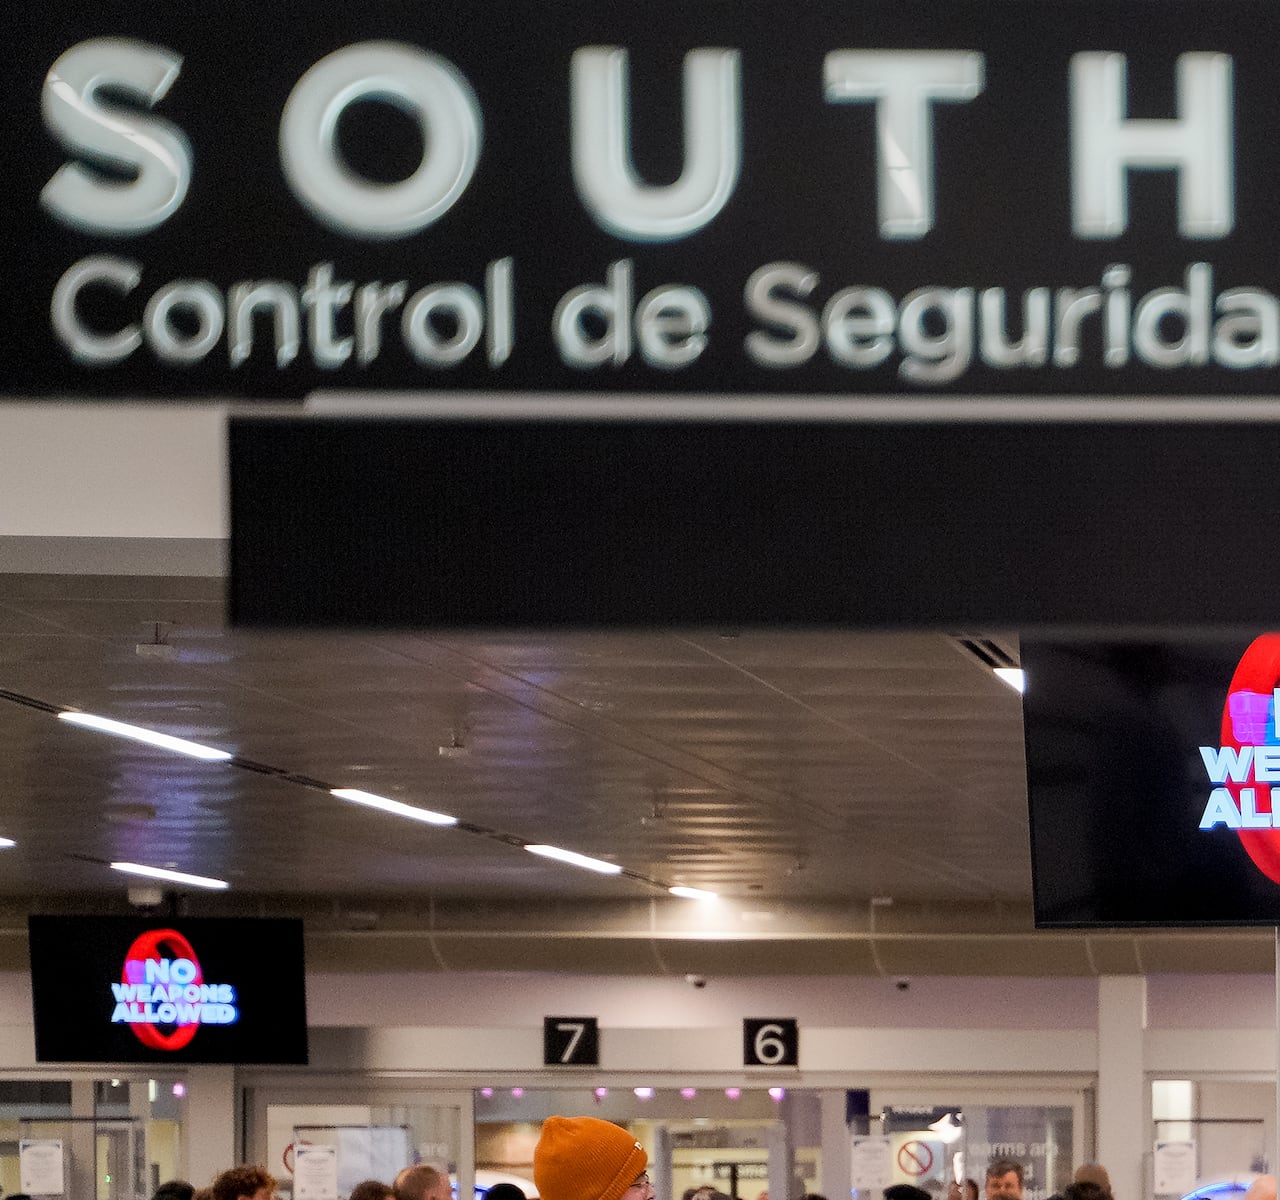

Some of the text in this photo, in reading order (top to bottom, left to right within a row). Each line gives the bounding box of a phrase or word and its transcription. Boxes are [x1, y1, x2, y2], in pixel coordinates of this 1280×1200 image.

[40, 36, 1236, 242] SOUTH
[48, 252, 516, 368] Control
[552, 258, 712, 368] de
[144, 958, 197, 984] NO
[111, 983, 234, 1003] WEAPONS
[111, 1002, 237, 1024] ALLOWED
[556, 1023, 585, 1063] 7
[754, 1024, 786, 1064] 6
